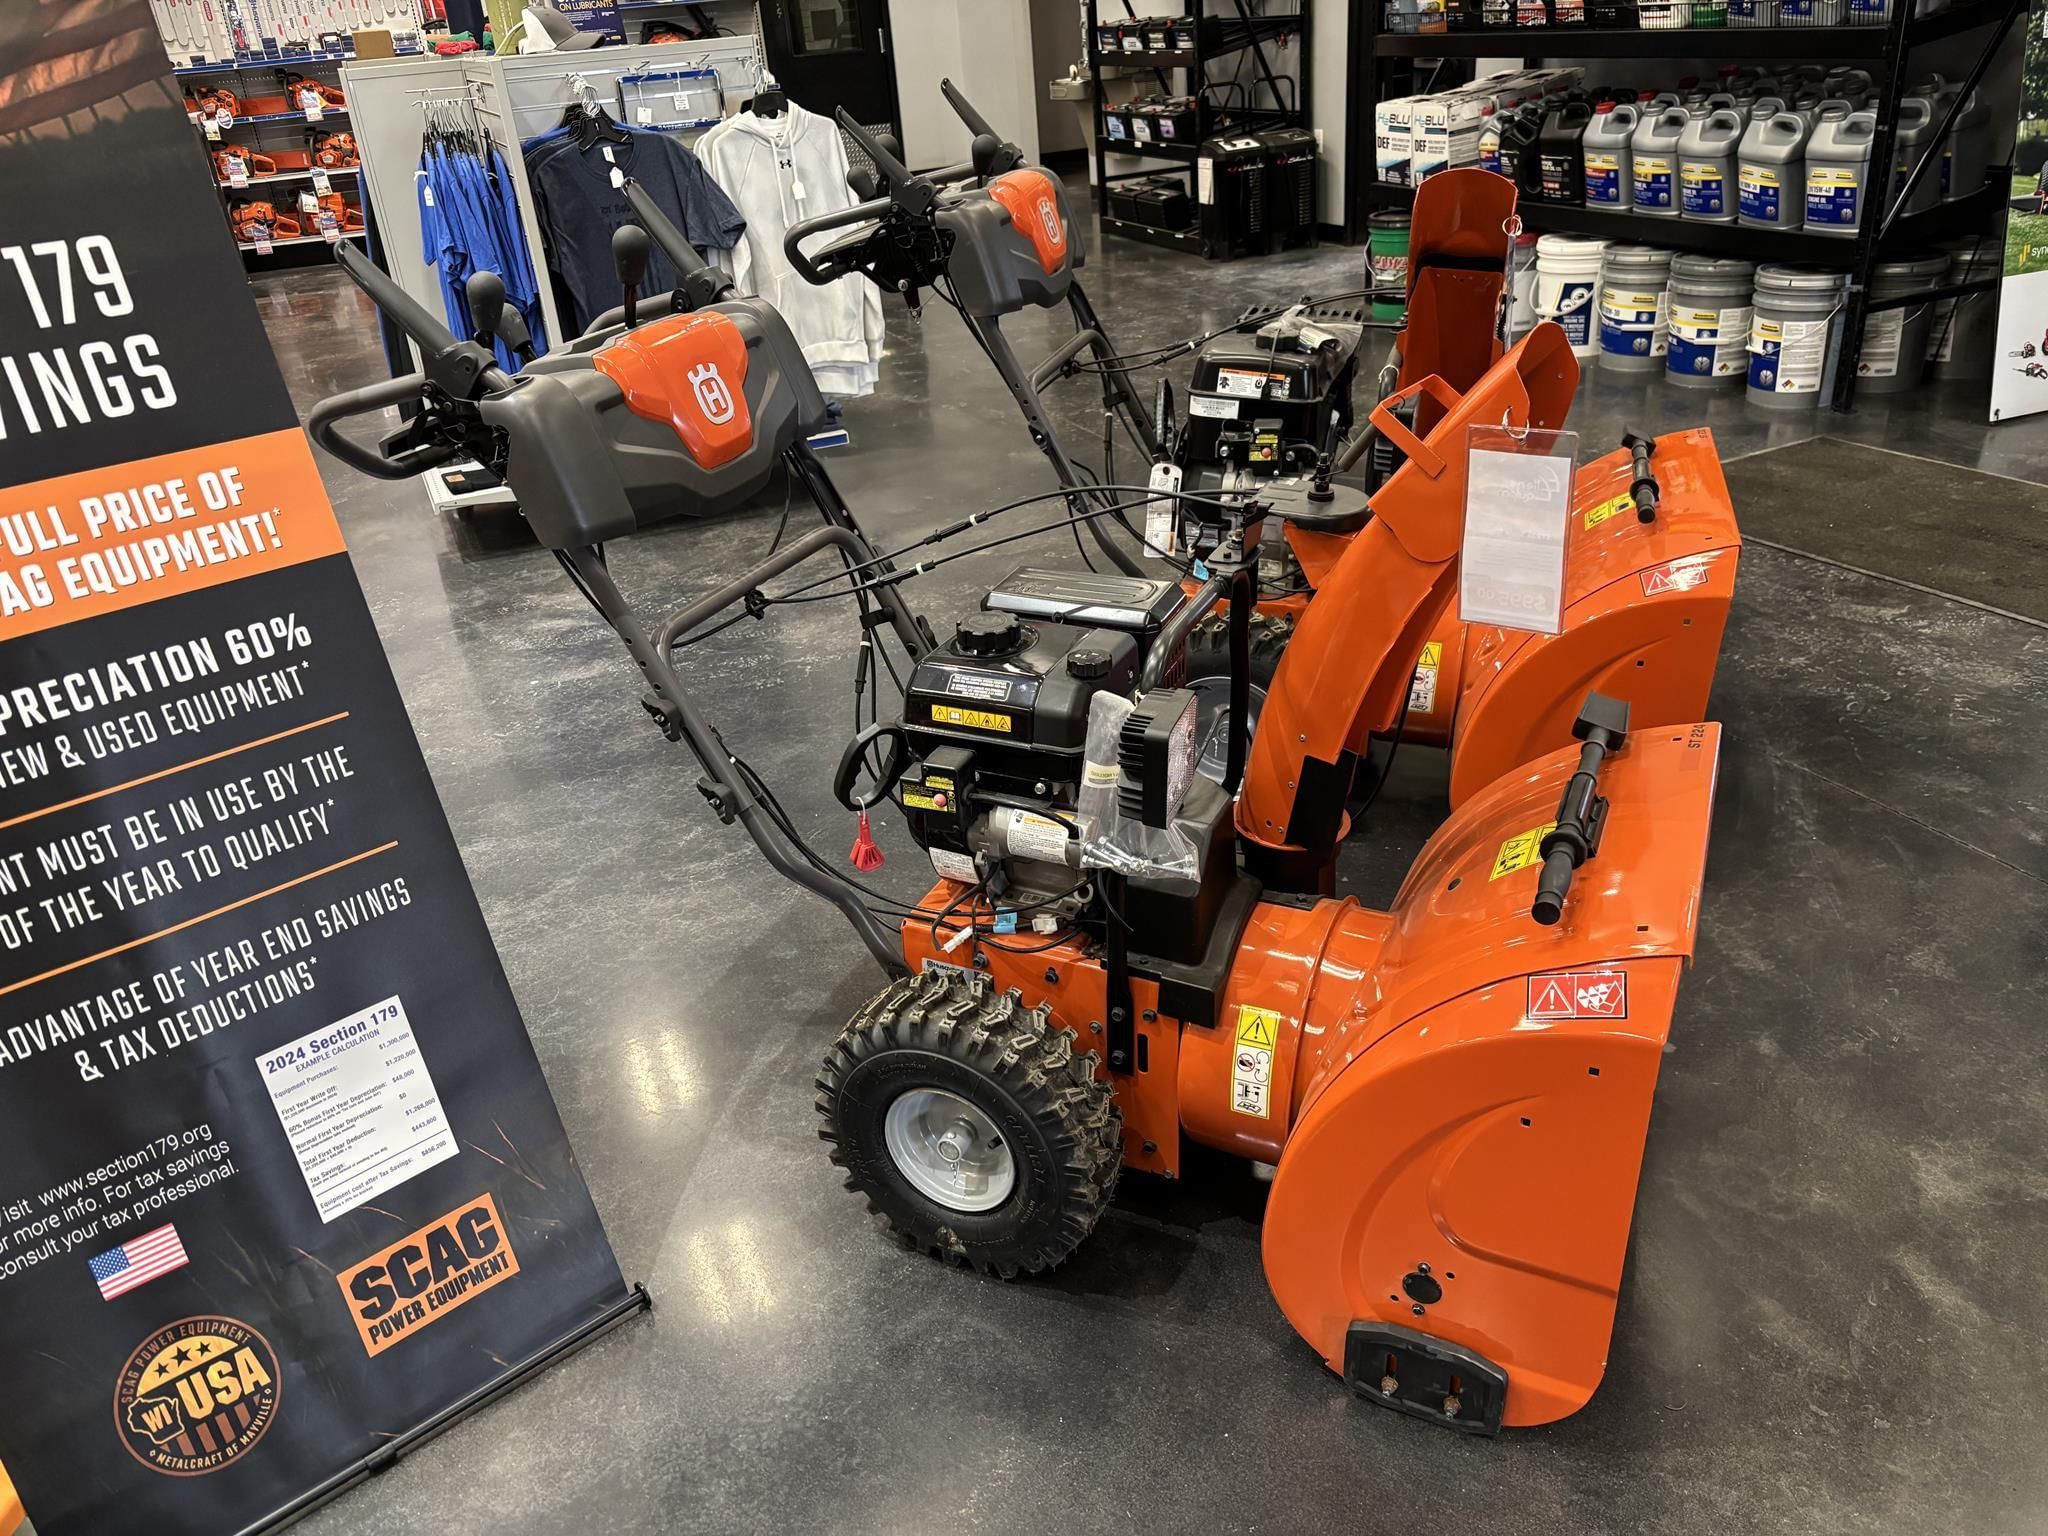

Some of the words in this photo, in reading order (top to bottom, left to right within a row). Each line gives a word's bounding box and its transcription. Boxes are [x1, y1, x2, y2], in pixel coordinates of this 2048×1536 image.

[572, 0, 614, 10] LUBRICANTS
[1377, 136, 1390, 149] DEF
[1415, 140, 1427, 152] DEF
[1, 234, 134, 328] 179
[0, 333, 177, 440] INGS
[0, 505, 79, 556] ULL
[79, 478, 196, 542] PRICE
[196, 465, 245, 510] OF
[224, 612, 313, 666] 60%
[55, 735, 86, 769] &
[83, 710, 158, 760] USED
[1691, 724, 1707, 738] 224
[36, 825, 121, 882] MUST
[123, 810, 168, 851] BE
[168, 798, 205, 836] IN
[206, 777, 263, 822] USE
[262, 762, 301, 802] BY
[301, 745, 355, 788] THE
[0, 906, 35, 951] OF
[39, 886, 103, 936] THE
[102, 858, 184, 913] YEAR
[182, 843, 222, 884] TO
[152, 965, 187, 1005] OF
[190, 938, 261, 987] YEAR
[261, 916, 313, 961] END
[314, 877, 412, 938] SAVINGS
[74, 1048, 105, 1083] &
[99, 1025, 158, 1071] TAX
[265, 1047, 306, 1074] 2024
[309, 1020, 367, 1054] Section
[370, 1004, 399, 1026] 179
[295, 1051, 331, 1073] EXAMPLE
[331, 1028, 380, 1056] CALCULATION
[274, 1080, 306, 1099] Equipment
[306, 1065, 339, 1083] Purchases:
[281, 1105, 296, 1117] First
[296, 1098, 310, 1110] Year
[309, 1090, 326, 1103] Write
[289, 1122, 303, 1133] 60%
[302, 1112, 322, 1127] Bonus
[321, 1105, 336, 1118] First
[335, 1099, 350, 1112] Year
[350, 1081, 388, 1104] Depreciation:
[295, 1136, 318, 1150] Normal
[317, 1129, 333, 1141] First
[332, 1122, 346, 1134] Year
[345, 1104, 384, 1127] Depreciation:
[302, 1155, 319, 1168] Total
[318, 1148, 333, 1161] First
[332, 1141, 346, 1154] Year
[346, 1127, 377, 1146] Deduction:
[0, 1198, 33, 1228] isit
[38, 1123, 213, 1207] www.section179.org
[13, 1214, 61, 1245] more
[61, 1196, 102, 1223] info.
[102, 1181, 137, 1204] For
[135, 1167, 165, 1190] tax
[166, 1140, 231, 1177] savings
[309, 1174, 320, 1185] Tax
[320, 1162, 346, 1179] Savings:
[319, 1190, 351, 1210] Equipment
[351, 1182, 365, 1193] cost
[364, 1174, 379, 1187] after
[378, 1170, 389, 1180] Tax
[389, 1157, 414, 1174] Savings:
[0, 1239, 60, 1280] consult
[60, 1221, 99, 1253] your
[102, 1207, 132, 1231] tax
[133, 1158, 240, 1220] professional.
[350, 1206, 501, 1321] SCAG
[367, 1299, 427, 1346] POWER
[425, 1249, 510, 1313] EQUIPMENT
[121, 1369, 140, 1404] SCAG
[136, 1329, 177, 1368] POWER
[179, 1321, 253, 1345] EQUIPMENT
[176, 1345, 272, 1420] USA
[141, 1402, 174, 1434] WI
[155, 1451, 224, 1470] METALCRAFT
[226, 1441, 240, 1458] OF
[239, 1397, 272, 1447] MAYVILLE
